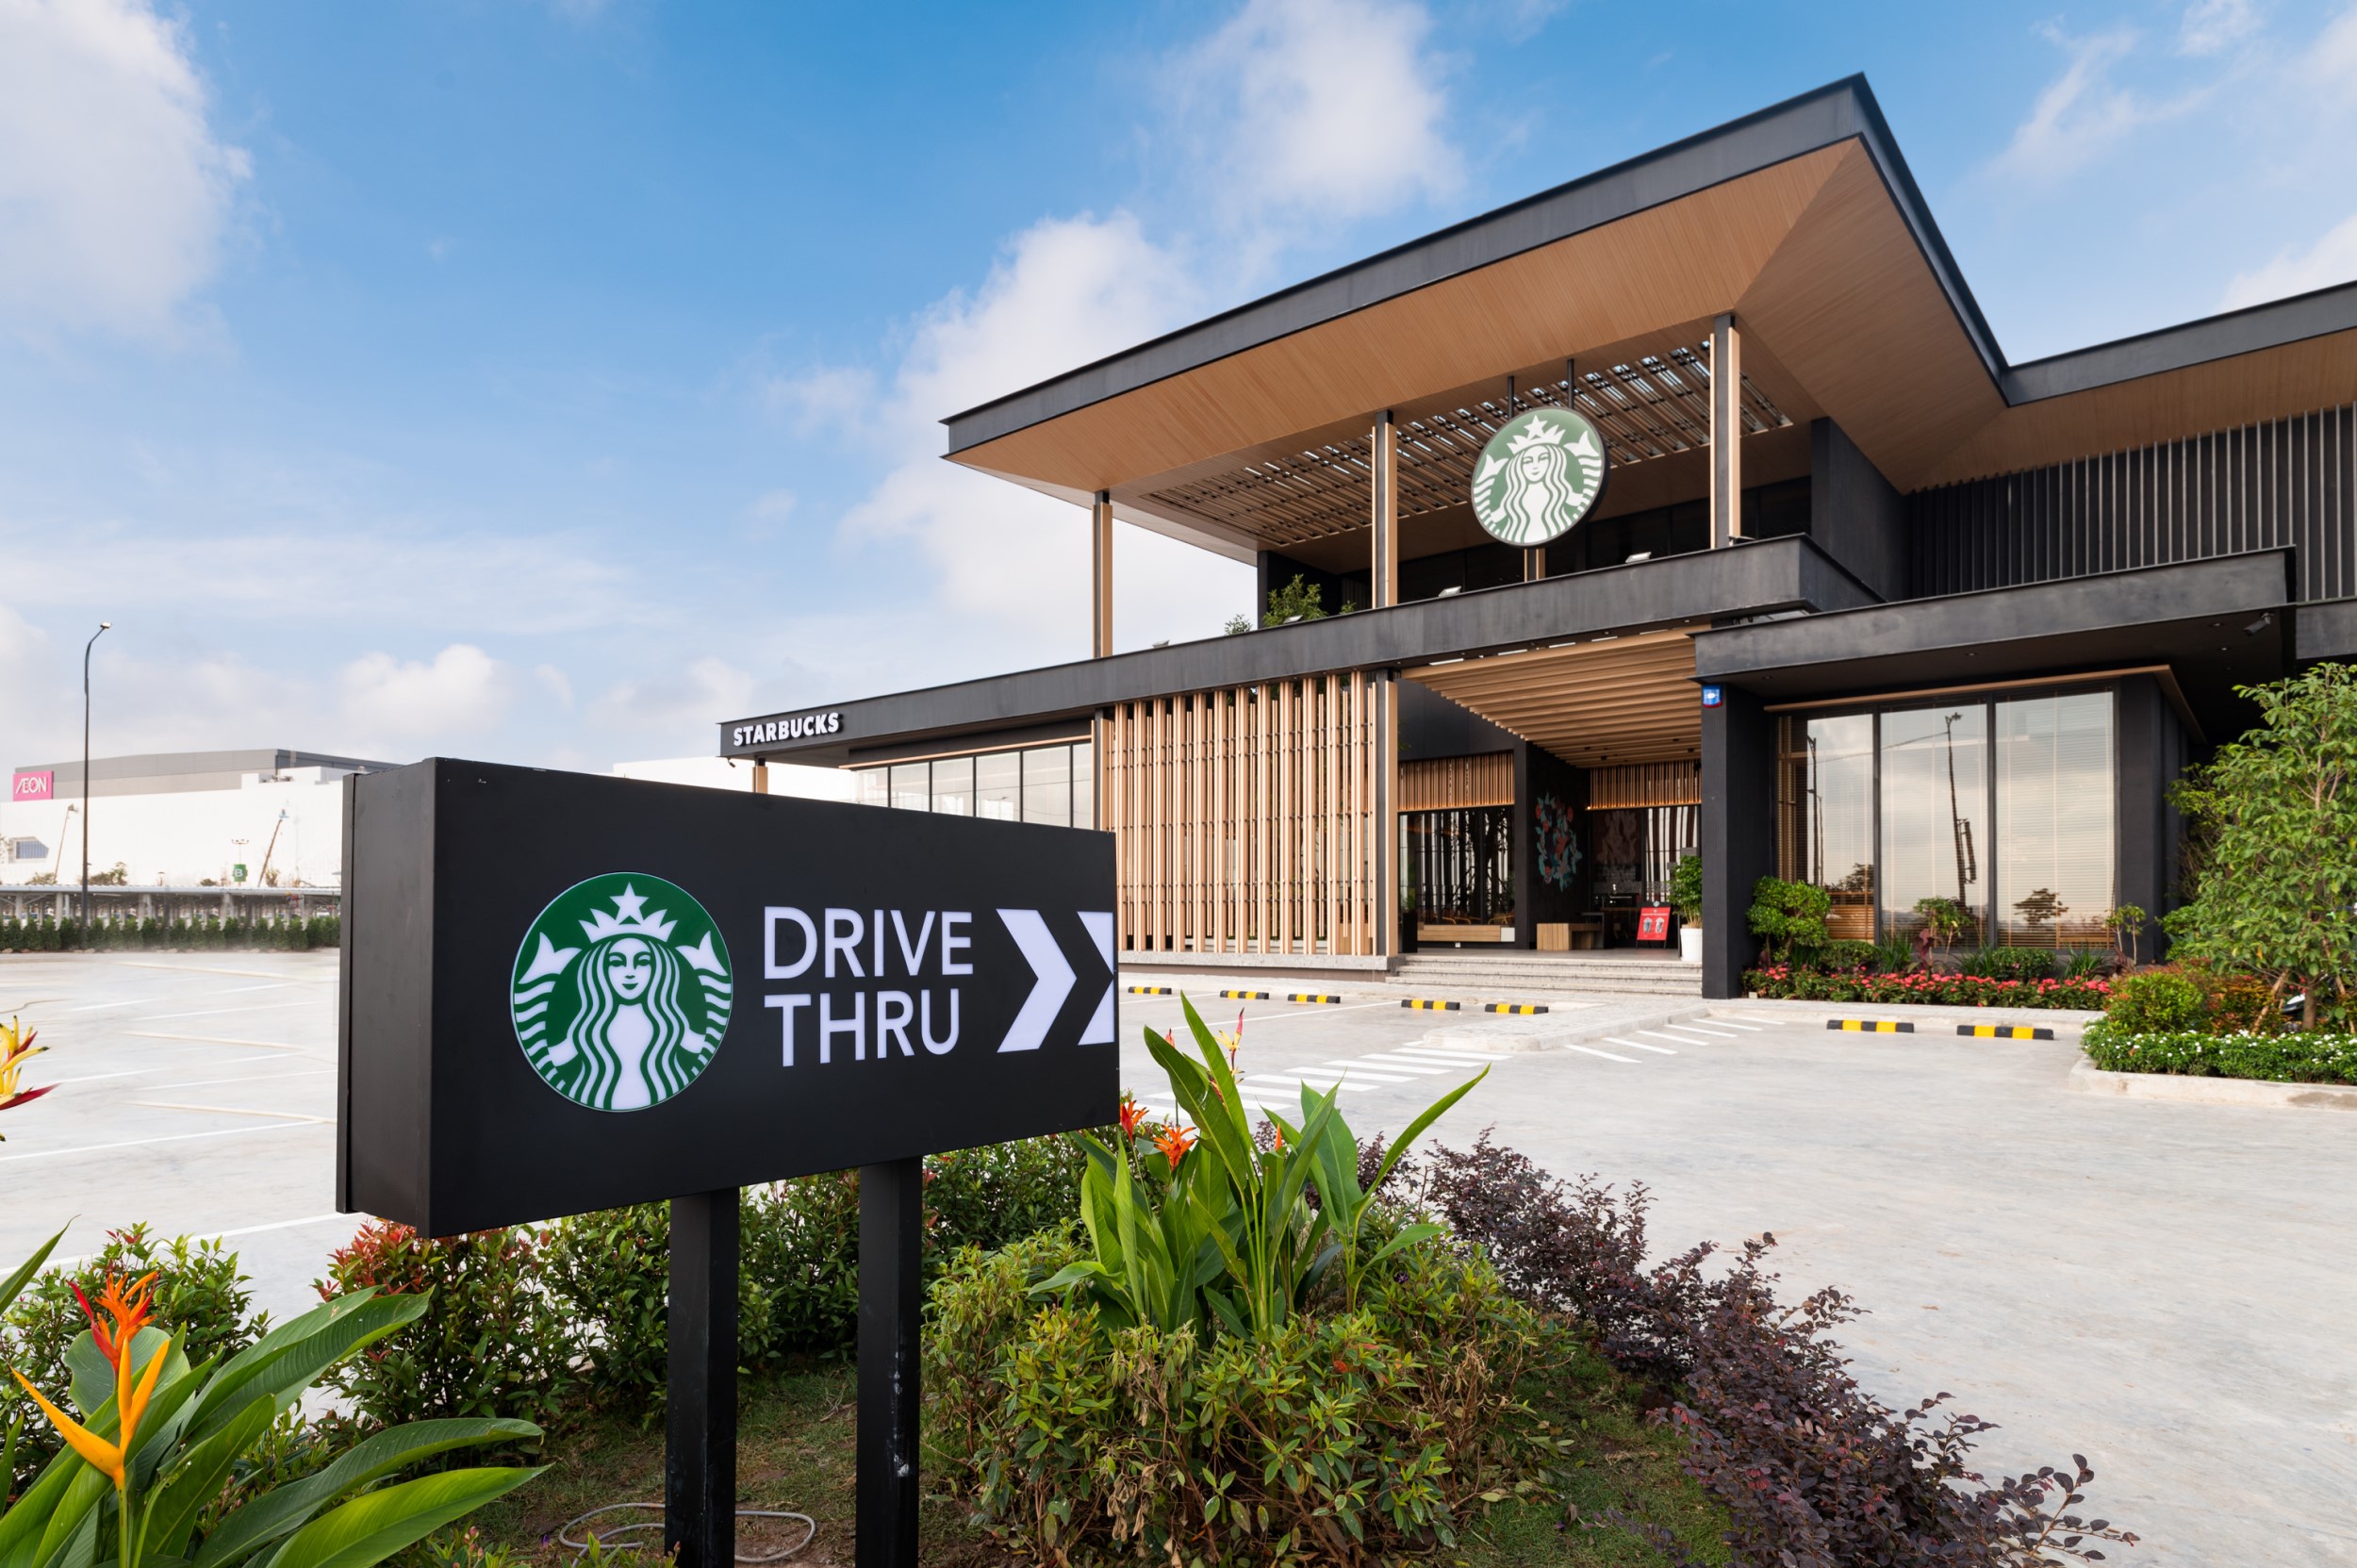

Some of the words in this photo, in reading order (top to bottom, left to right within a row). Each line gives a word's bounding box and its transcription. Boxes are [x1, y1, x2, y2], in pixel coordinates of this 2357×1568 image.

[733, 712, 839, 747] STARBUCKS
[764, 906, 973, 980] DRIVE
[764, 988, 960, 1067] THRU
